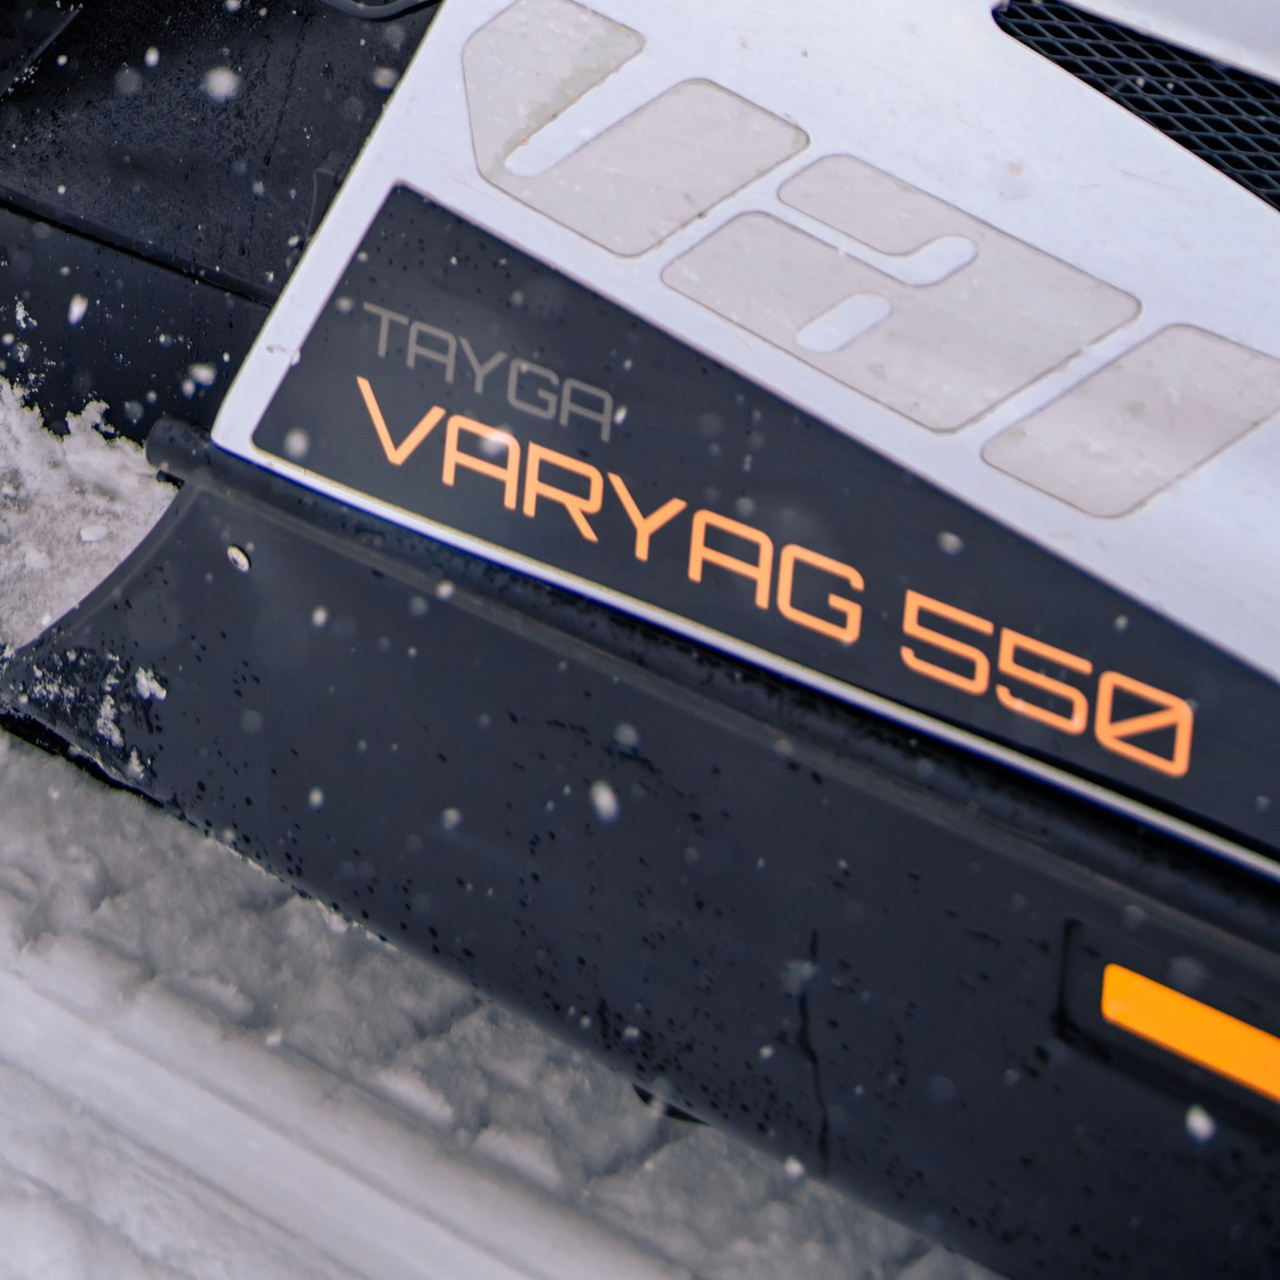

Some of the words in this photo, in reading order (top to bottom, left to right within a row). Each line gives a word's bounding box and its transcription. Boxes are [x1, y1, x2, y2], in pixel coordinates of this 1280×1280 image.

[363, 301, 614, 443] TAYGA
[356, 376, 865, 643] VARYAG
[900, 589, 1194, 778] 550
